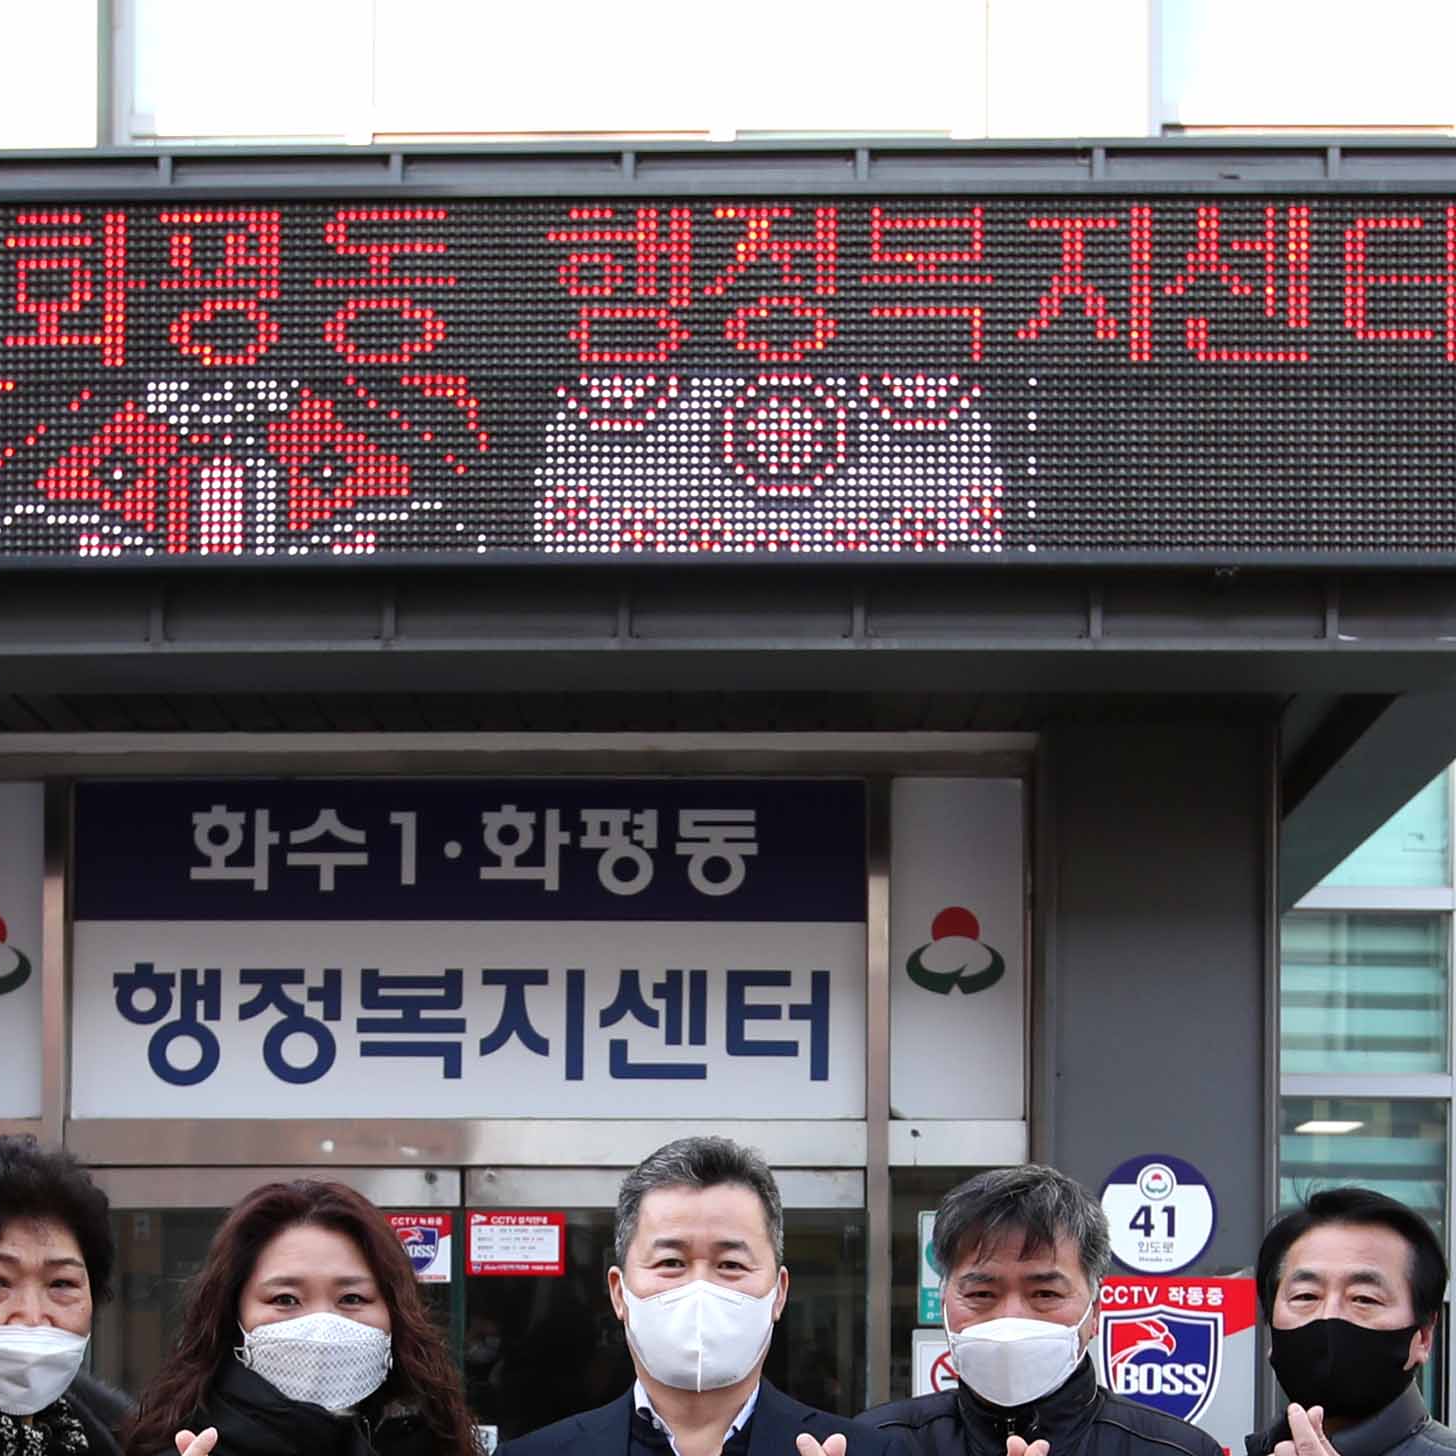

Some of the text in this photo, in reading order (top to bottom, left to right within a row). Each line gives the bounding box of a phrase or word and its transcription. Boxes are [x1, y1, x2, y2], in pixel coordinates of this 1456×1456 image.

[188, 802, 760, 899] 화수1·화평동
[113, 961, 832, 1088] 행정복지센터
[391, 1216, 417, 1226] CCTV
[490, 1216, 517, 1225] CCTV
[1129, 1205, 1176, 1238] 41
[1100, 1285, 1225, 1306] CCTV 작동중
[1116, 1362, 1208, 1396] BOSS
